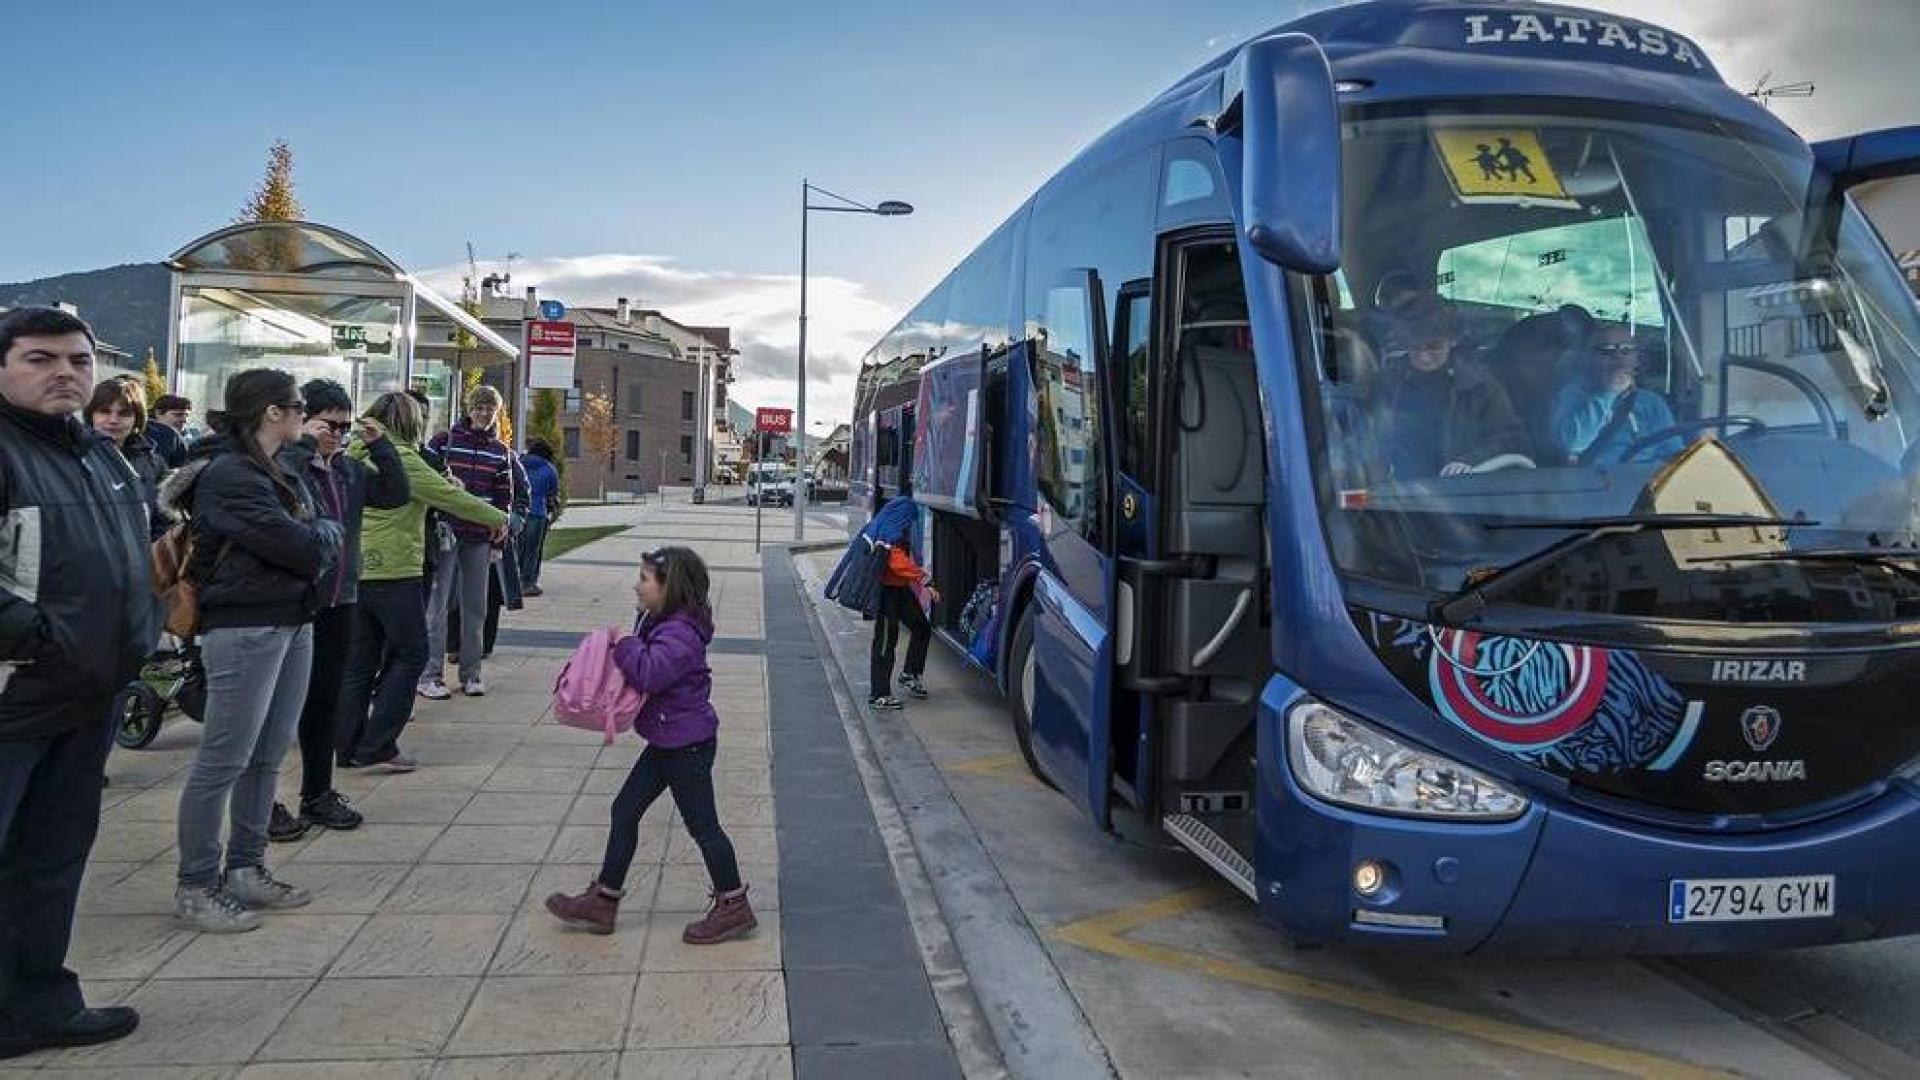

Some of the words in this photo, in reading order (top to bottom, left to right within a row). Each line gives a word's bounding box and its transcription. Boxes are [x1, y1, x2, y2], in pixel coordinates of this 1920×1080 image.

[1464, 14, 1703, 69] LATASA
[761, 414, 786, 426] BUS
[1711, 660, 1807, 682] IRIZAR
[1702, 759, 1808, 782] SCANIA
[1689, 884, 1764, 916] 2794
[1777, 881, 1830, 913] GYM
